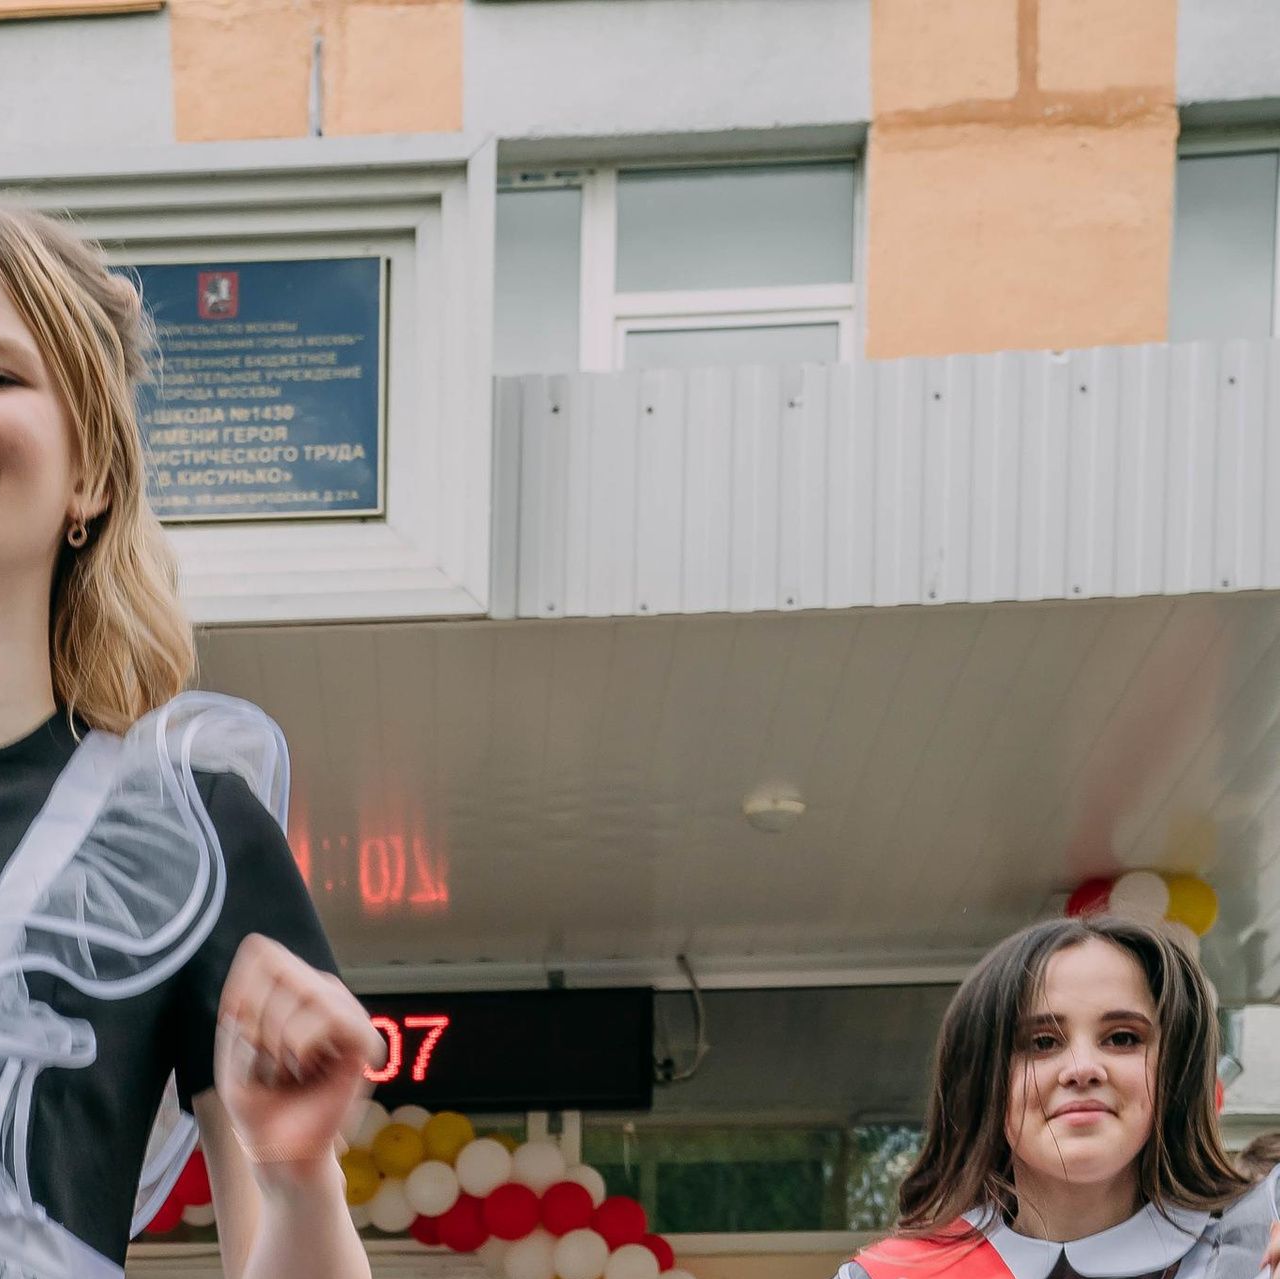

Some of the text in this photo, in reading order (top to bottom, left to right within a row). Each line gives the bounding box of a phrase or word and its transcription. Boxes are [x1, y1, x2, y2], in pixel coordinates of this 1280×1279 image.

[244, 352, 337, 367] БЮДЖЕТНОЕ
[265, 365, 363, 381] УЧРЕЖДЕНИЕ
[217, 386, 282, 398] МОСКВЫ
[150, 425, 288, 445] ИМЕНИ ГЕРОЯ
[303, 443, 366, 462] ТРУДА
[363, 1016, 450, 1082] 07
